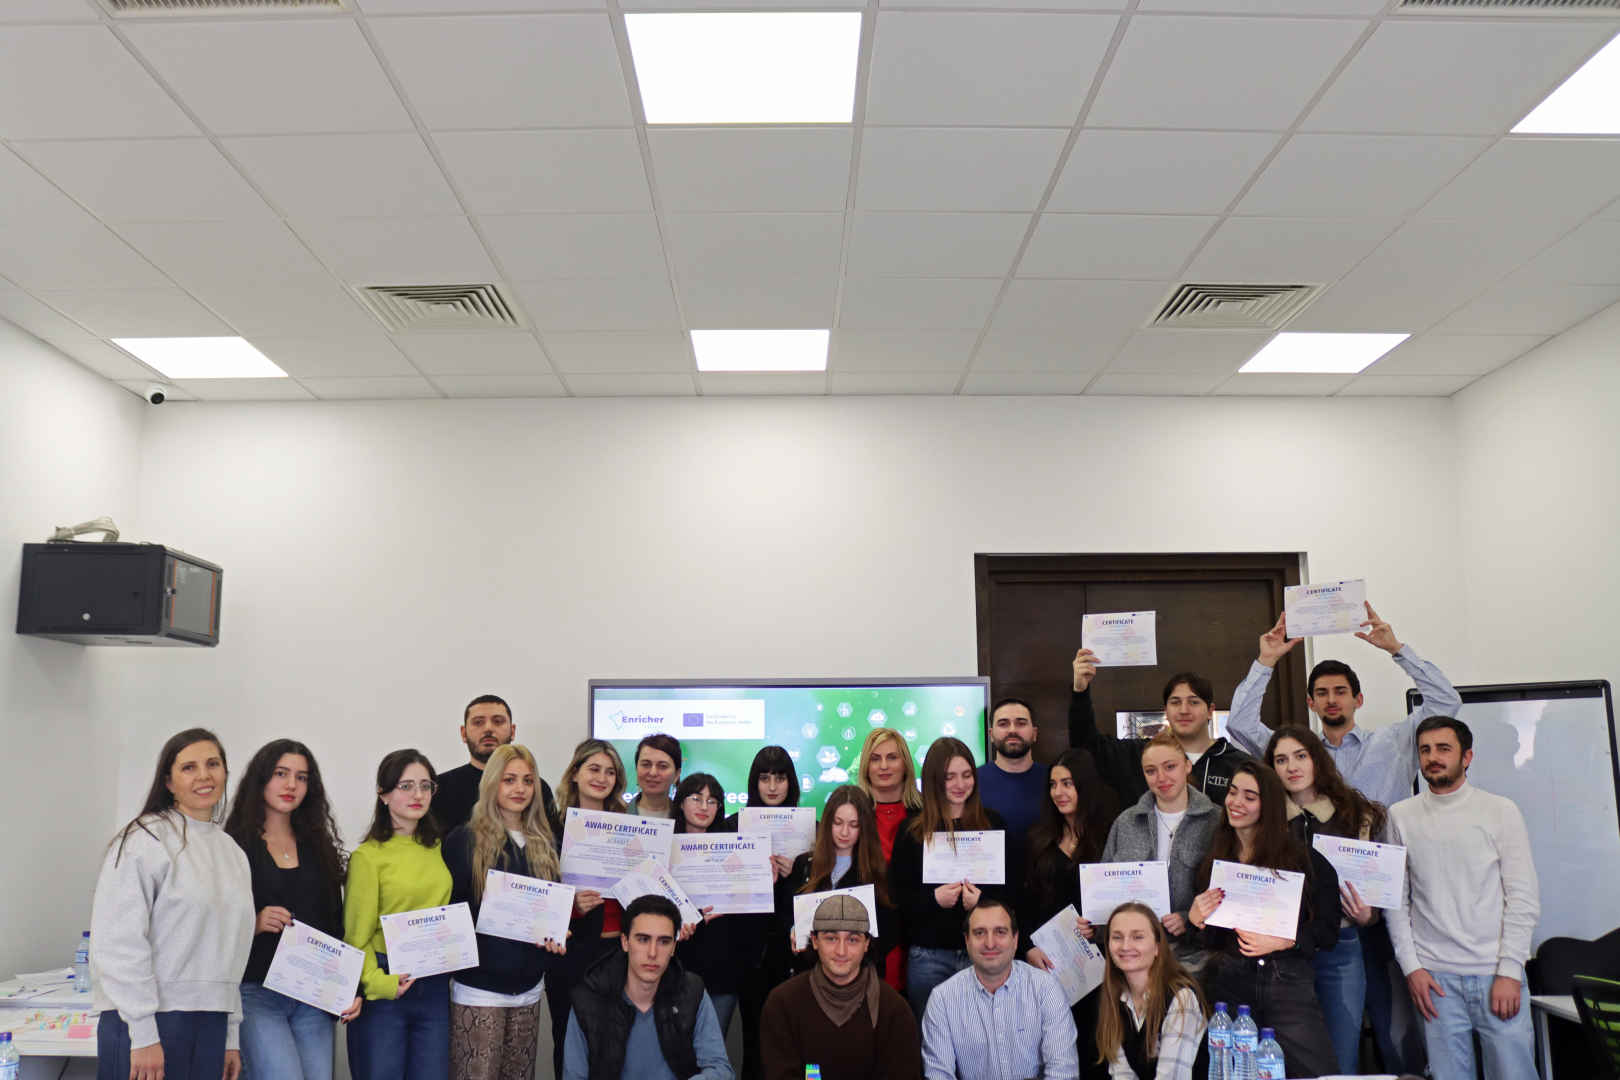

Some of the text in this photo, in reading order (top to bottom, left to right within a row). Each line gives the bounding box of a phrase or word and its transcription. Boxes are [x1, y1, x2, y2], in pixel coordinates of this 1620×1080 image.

[1306, 586, 1342, 595] CERTIFICATE
[622, 715, 664, 724] Enricher
[1207, 775, 1230, 787] NIK
[584, 821, 613, 831] AWARD
[614, 824, 658, 837] CERTIFICATE
[681, 842, 755, 851] AWARD CERTIFICATE
[1338, 845, 1379, 858] CERTIFICATE
[1104, 869, 1143, 877] CERTIFICATE
[1236, 872, 1276, 885] CERTIFICATE
[511, 882, 550, 896] CERTIFICATE
[659, 876, 683, 908] CERTIFICATE
[407, 914, 446, 927] CERTIFICATE
[307, 937, 342, 957] CERTIFICATE
[1074, 928, 1094, 961] CERTIFICATE
